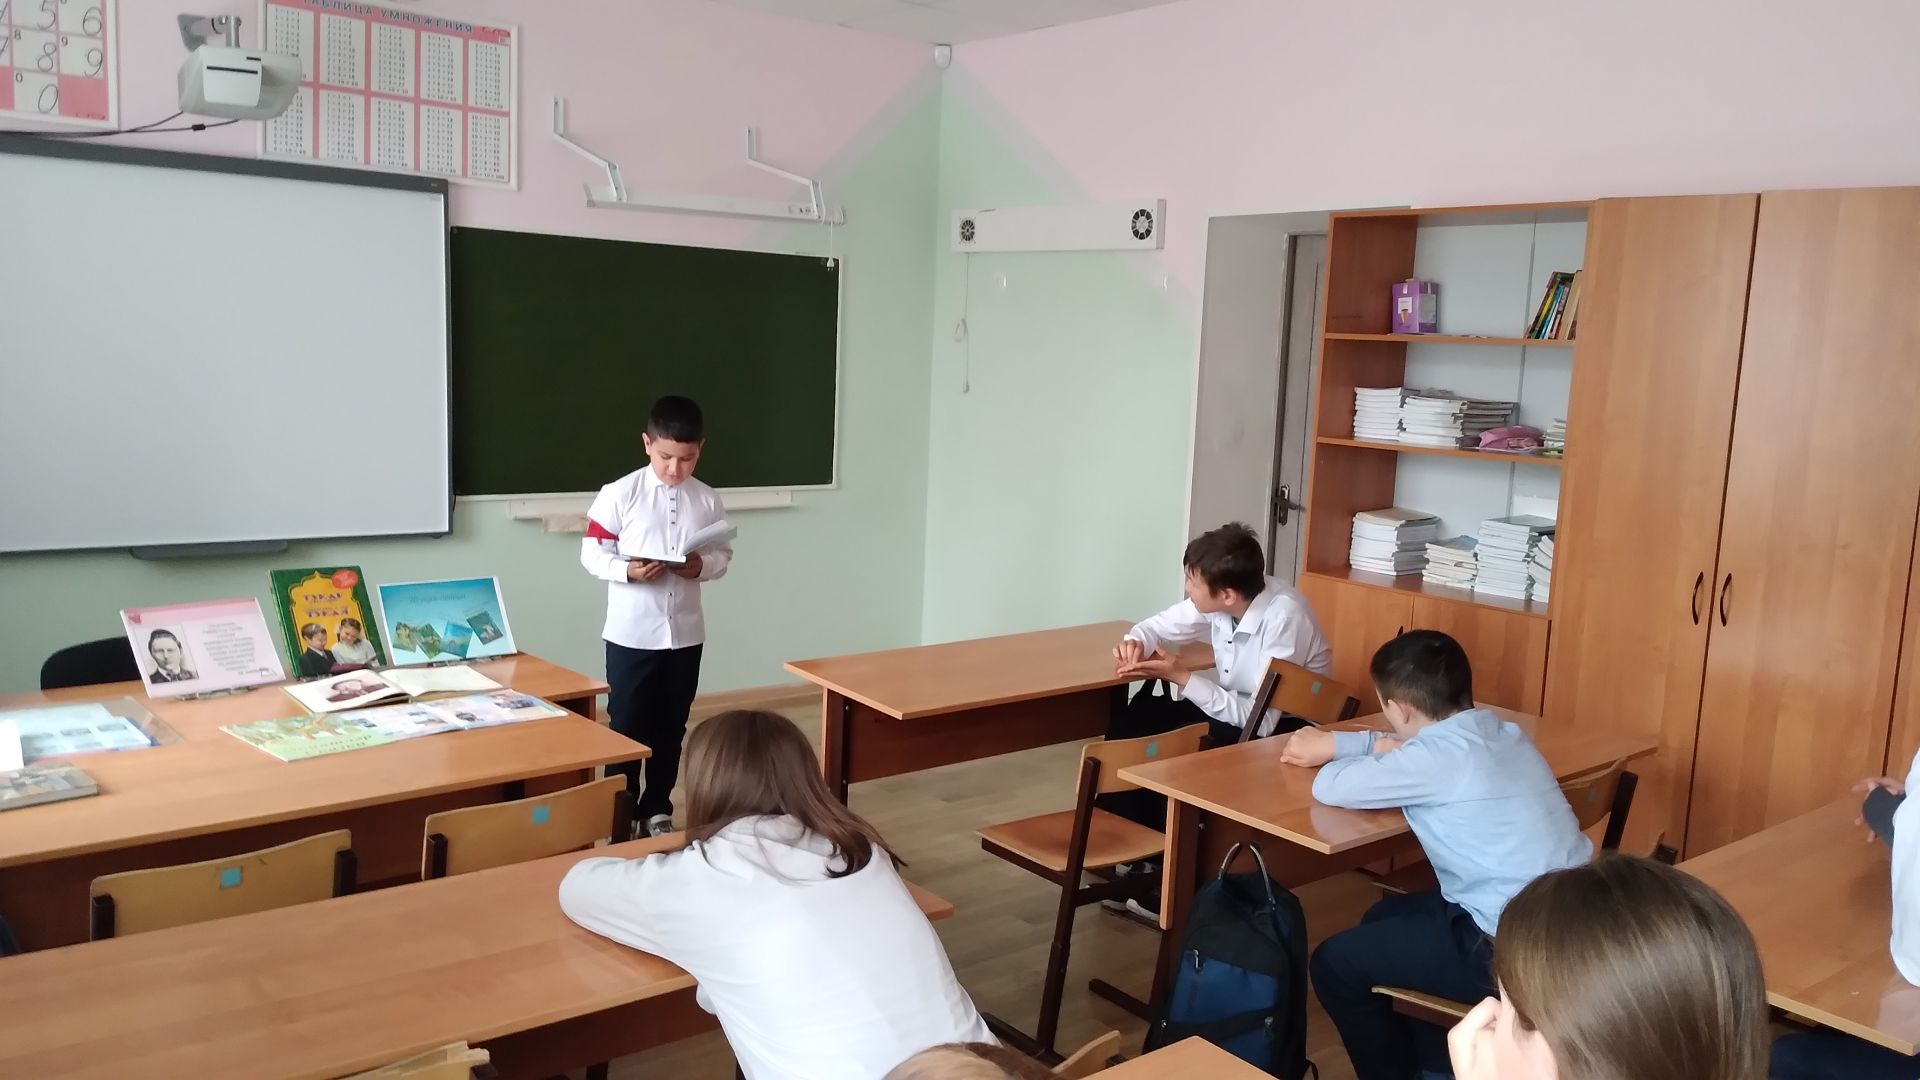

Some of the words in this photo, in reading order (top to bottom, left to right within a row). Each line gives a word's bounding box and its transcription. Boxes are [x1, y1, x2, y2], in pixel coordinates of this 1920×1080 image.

[37, 0, 56, 30] 5
[82, 6, 102, 37] 6
[381, 8, 472, 33] УМНОЖЕНИЯ
[37, 42, 57, 72] 8
[84, 47, 103, 77] 9
[38, 84, 58, 114] 0
